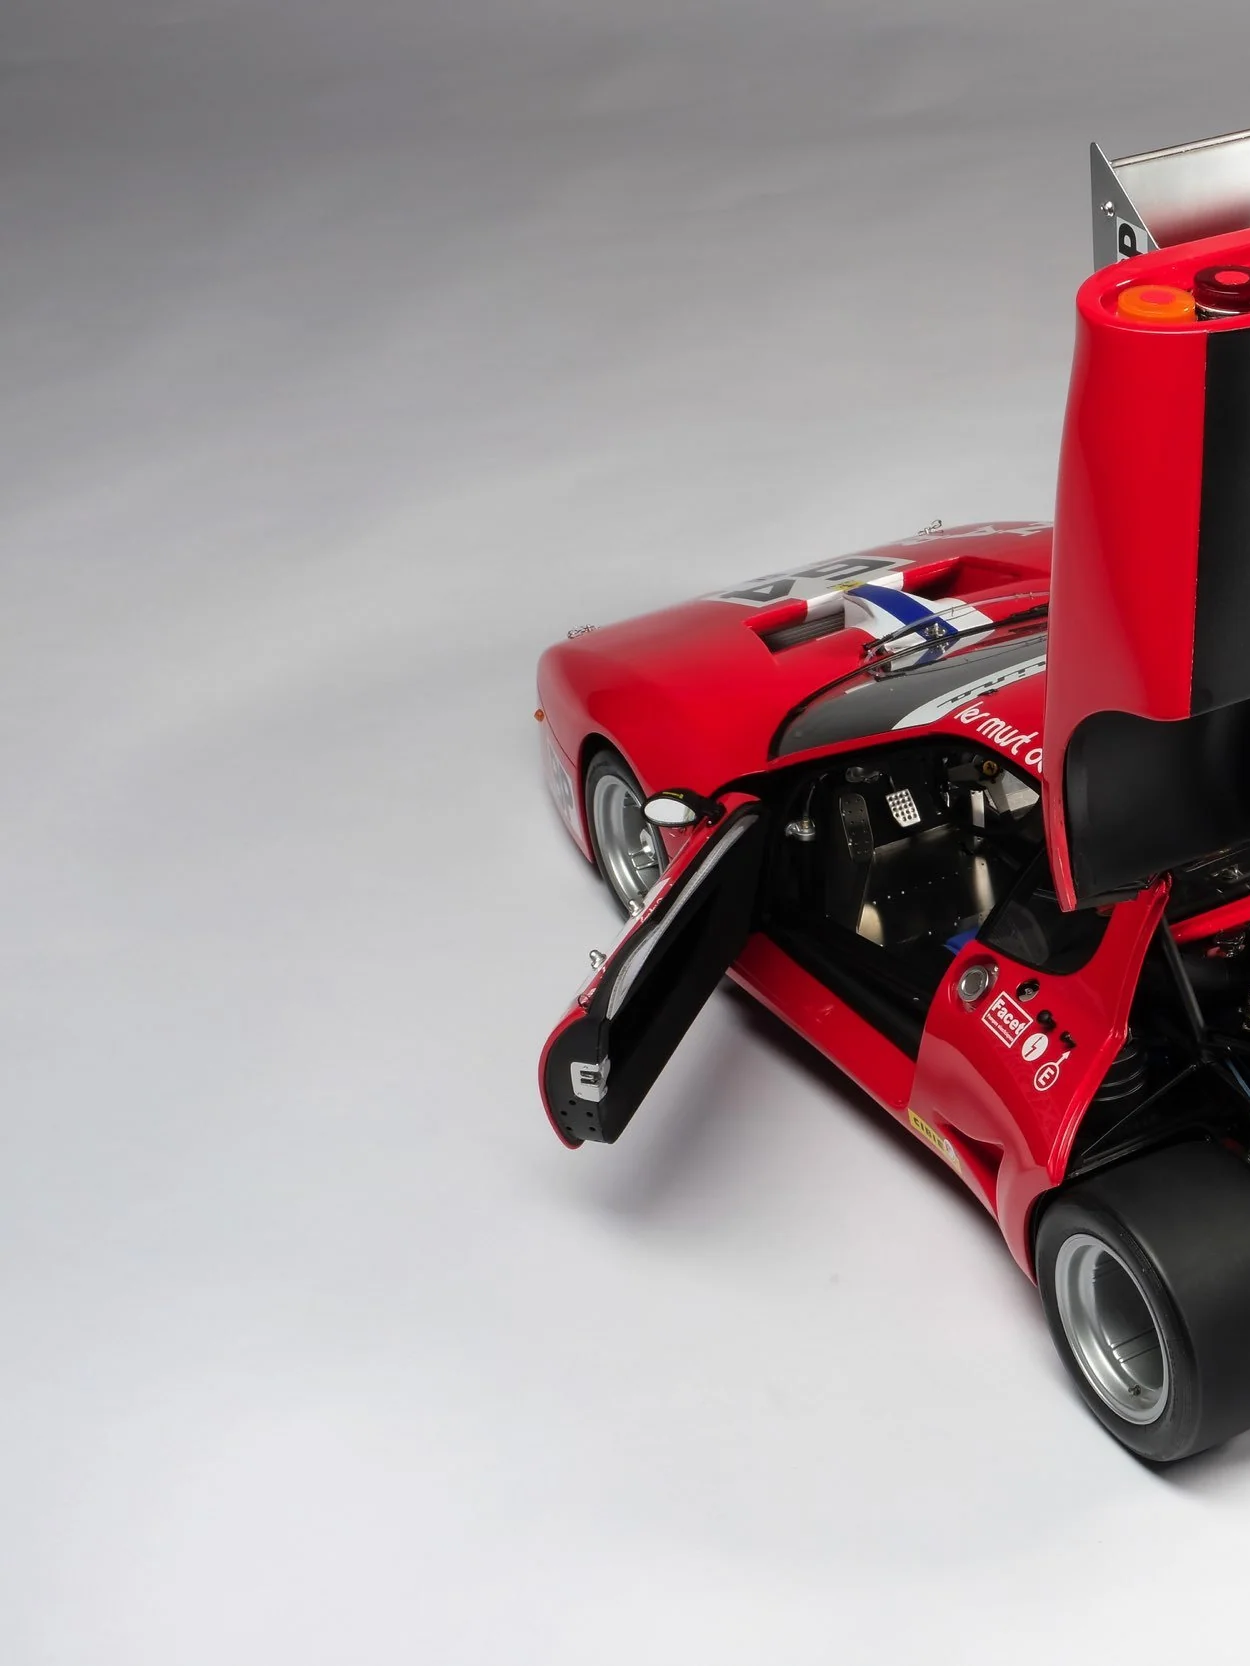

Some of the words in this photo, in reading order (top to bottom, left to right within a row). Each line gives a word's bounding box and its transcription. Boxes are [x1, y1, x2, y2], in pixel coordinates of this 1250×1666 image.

[976, 717, 1039, 755] must
[991, 998, 1026, 1035] Facet
[1037, 1067, 1055, 1086] E
